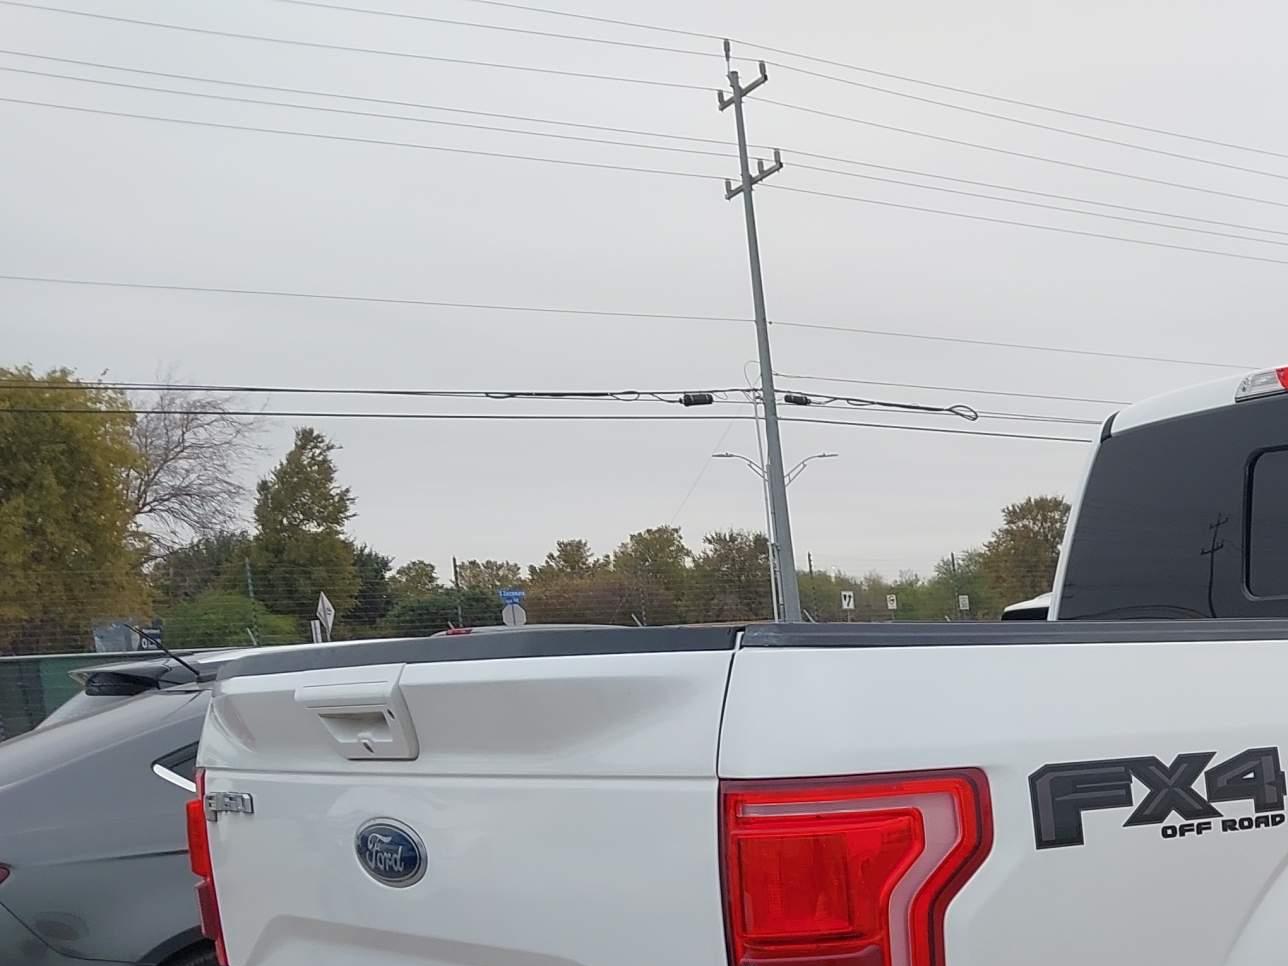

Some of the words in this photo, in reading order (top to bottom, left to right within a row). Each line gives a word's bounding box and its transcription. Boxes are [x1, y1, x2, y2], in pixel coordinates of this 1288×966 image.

[1028, 746, 1287, 850] FX4
[1161, 821, 1213, 840] OFF
[1222, 814, 1286, 834] ROAD
[366, 833, 404, 872] Ford
